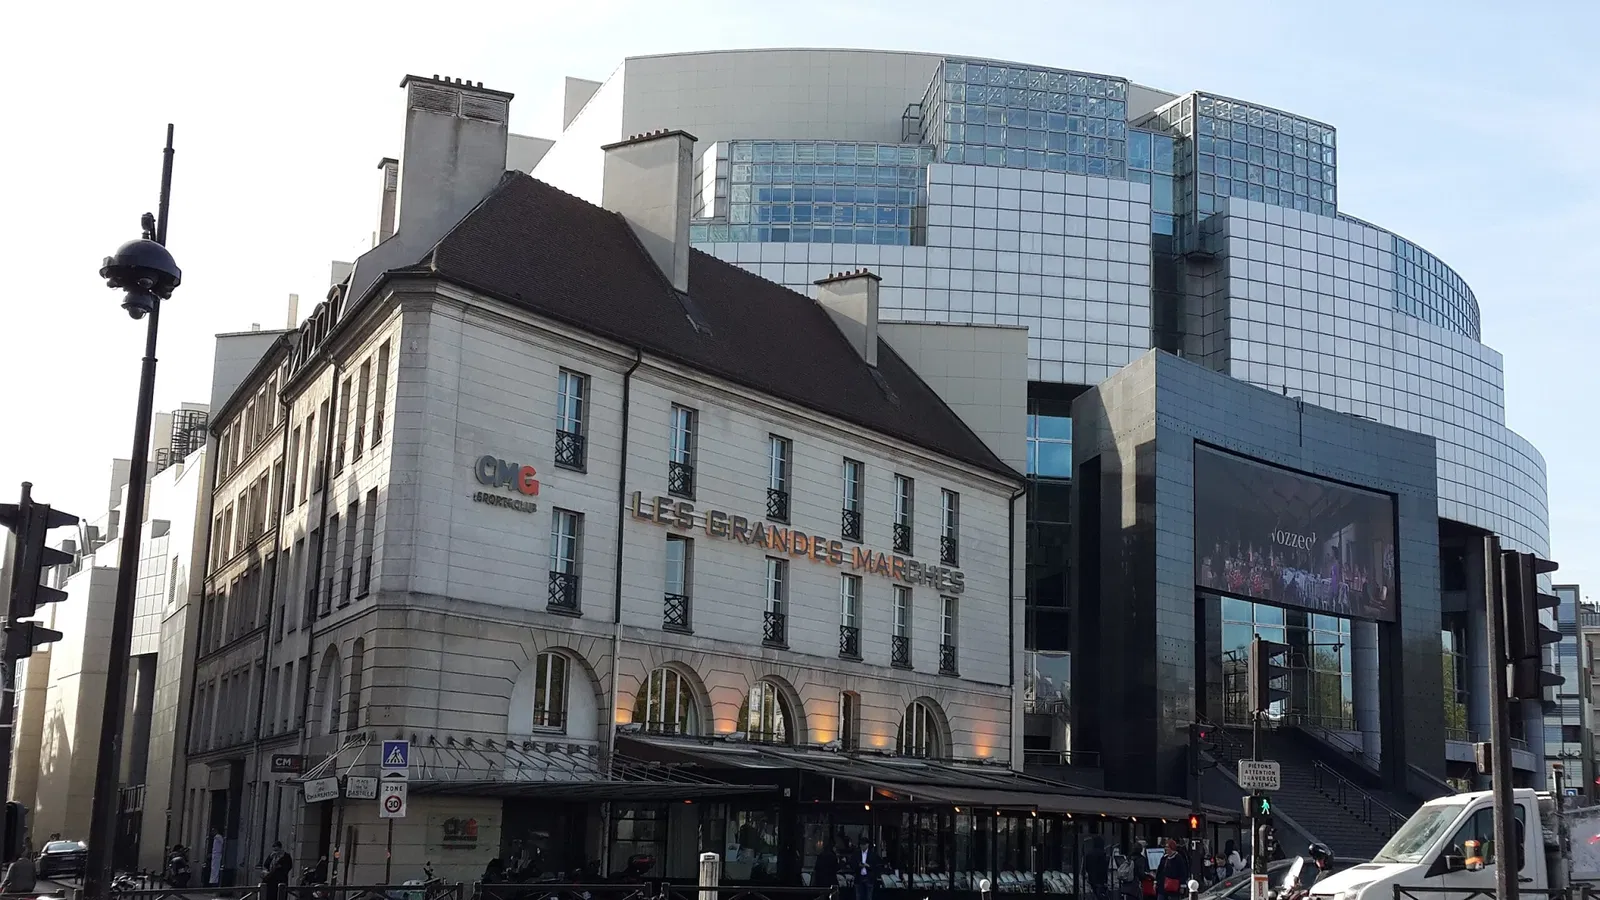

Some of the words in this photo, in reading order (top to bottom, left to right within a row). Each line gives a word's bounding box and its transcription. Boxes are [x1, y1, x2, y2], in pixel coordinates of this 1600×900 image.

[475, 455, 539, 496] CMG
[632, 490, 694, 530] LES
[706, 509, 843, 566] GRANDES
[852, 546, 965, 594] MARCHES
[306, 790, 338, 800] CHARENTON
[388, 800, 399, 808] 30
